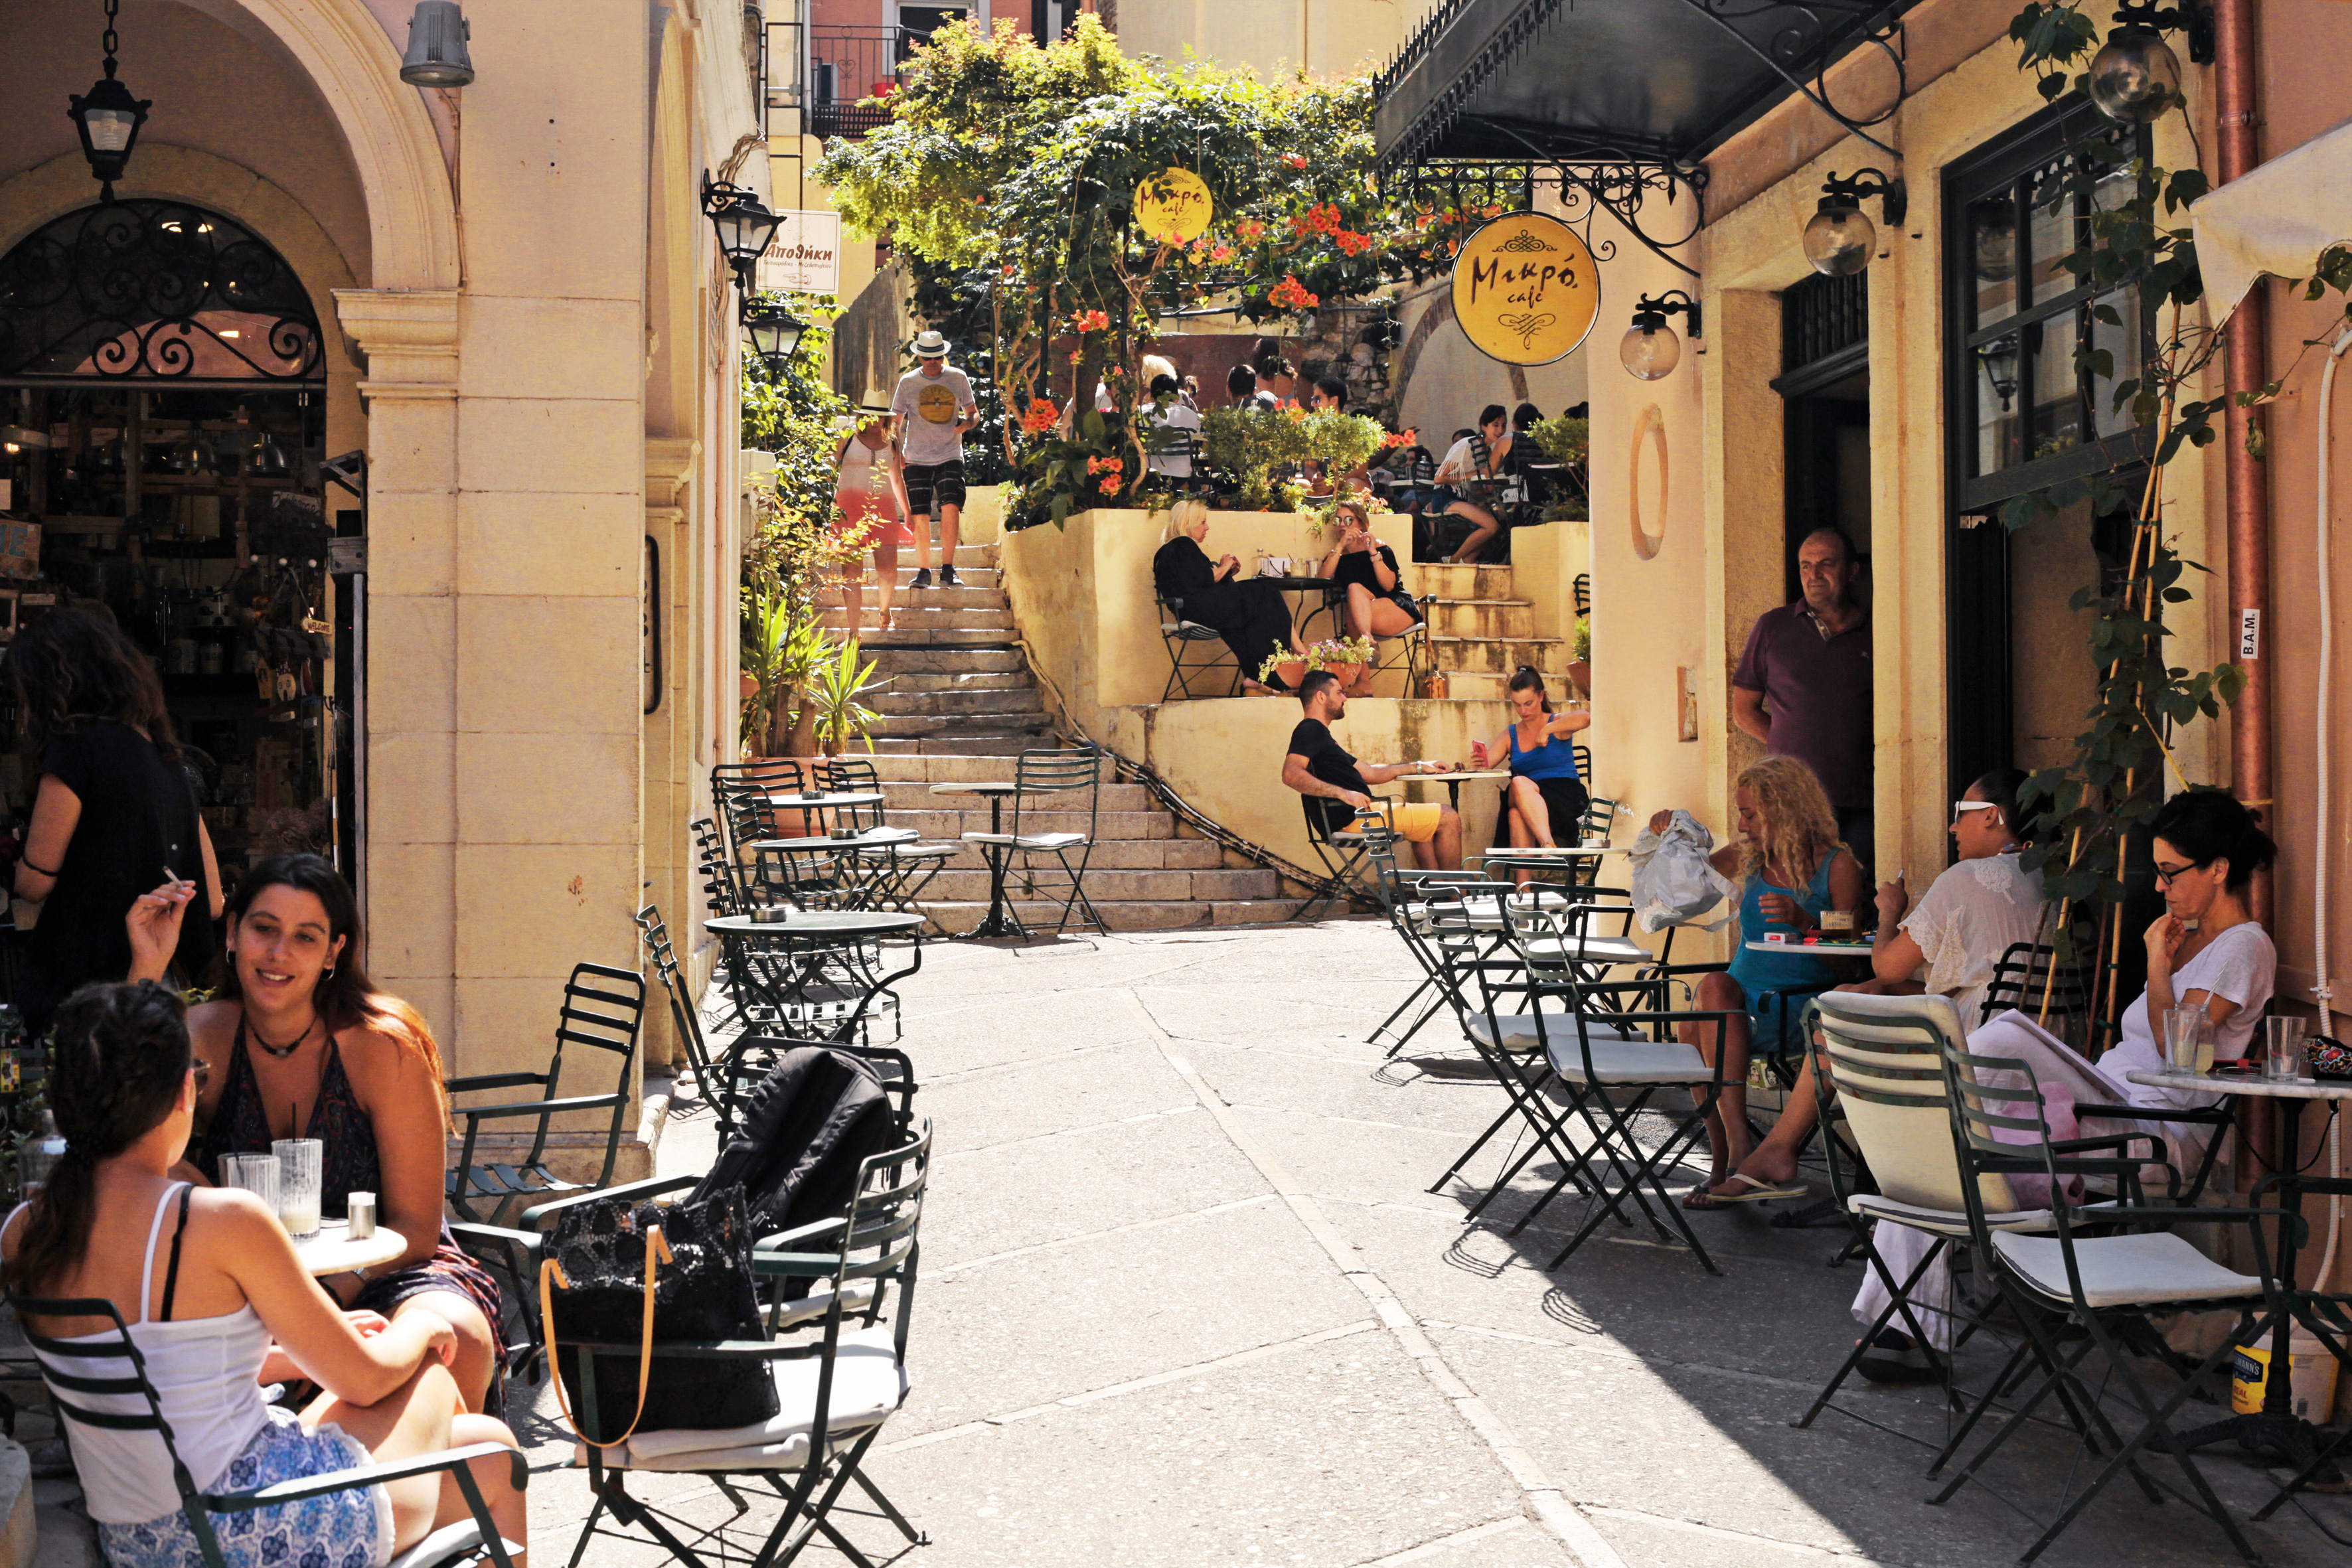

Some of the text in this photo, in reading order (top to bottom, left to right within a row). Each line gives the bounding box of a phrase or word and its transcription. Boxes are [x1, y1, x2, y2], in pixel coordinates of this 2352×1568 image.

[763, 243, 833, 262] Αποθήκη
[1471, 253, 1578, 306] Μικρό
[307, 621, 331, 633] WELCOME
